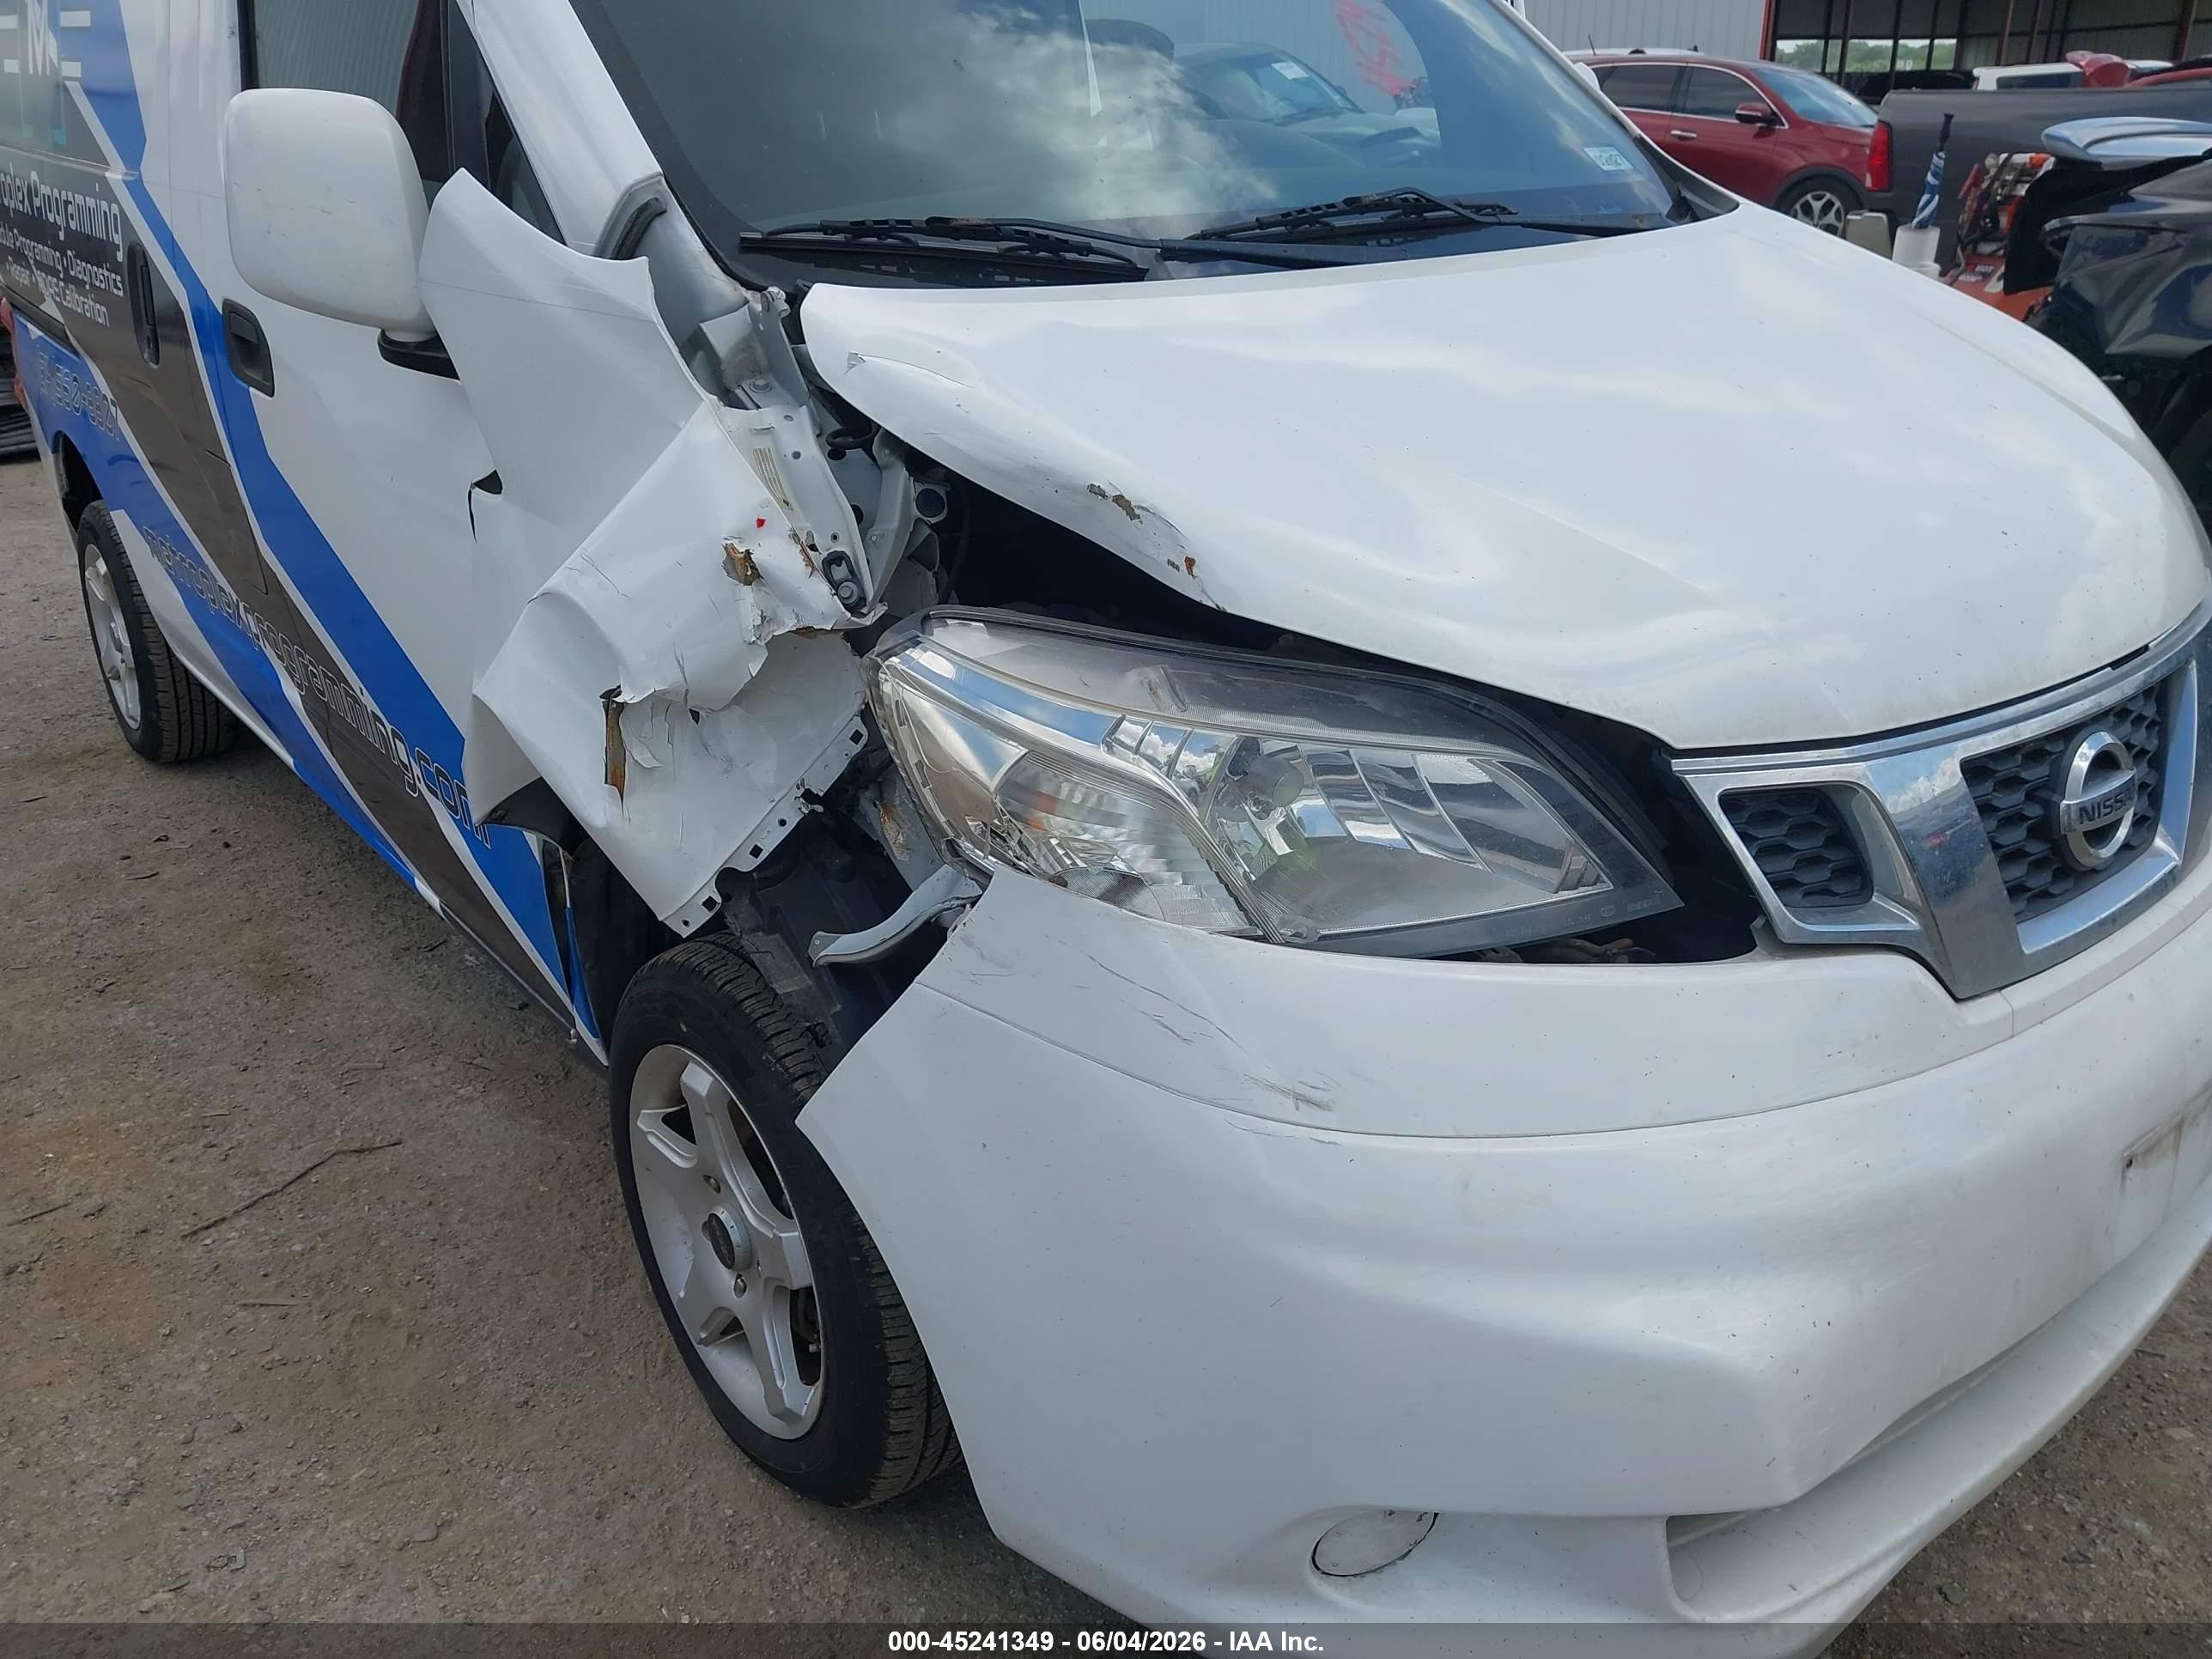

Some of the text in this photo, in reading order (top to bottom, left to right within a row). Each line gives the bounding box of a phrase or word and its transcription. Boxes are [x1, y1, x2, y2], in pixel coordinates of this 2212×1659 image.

[30, 170, 124, 262] Programming
[13, 228, 64, 279] Programming
[66, 249, 124, 297] Diagnostics
[60, 280, 110, 328] Calibration
[2078, 787, 2135, 826] NISSA
